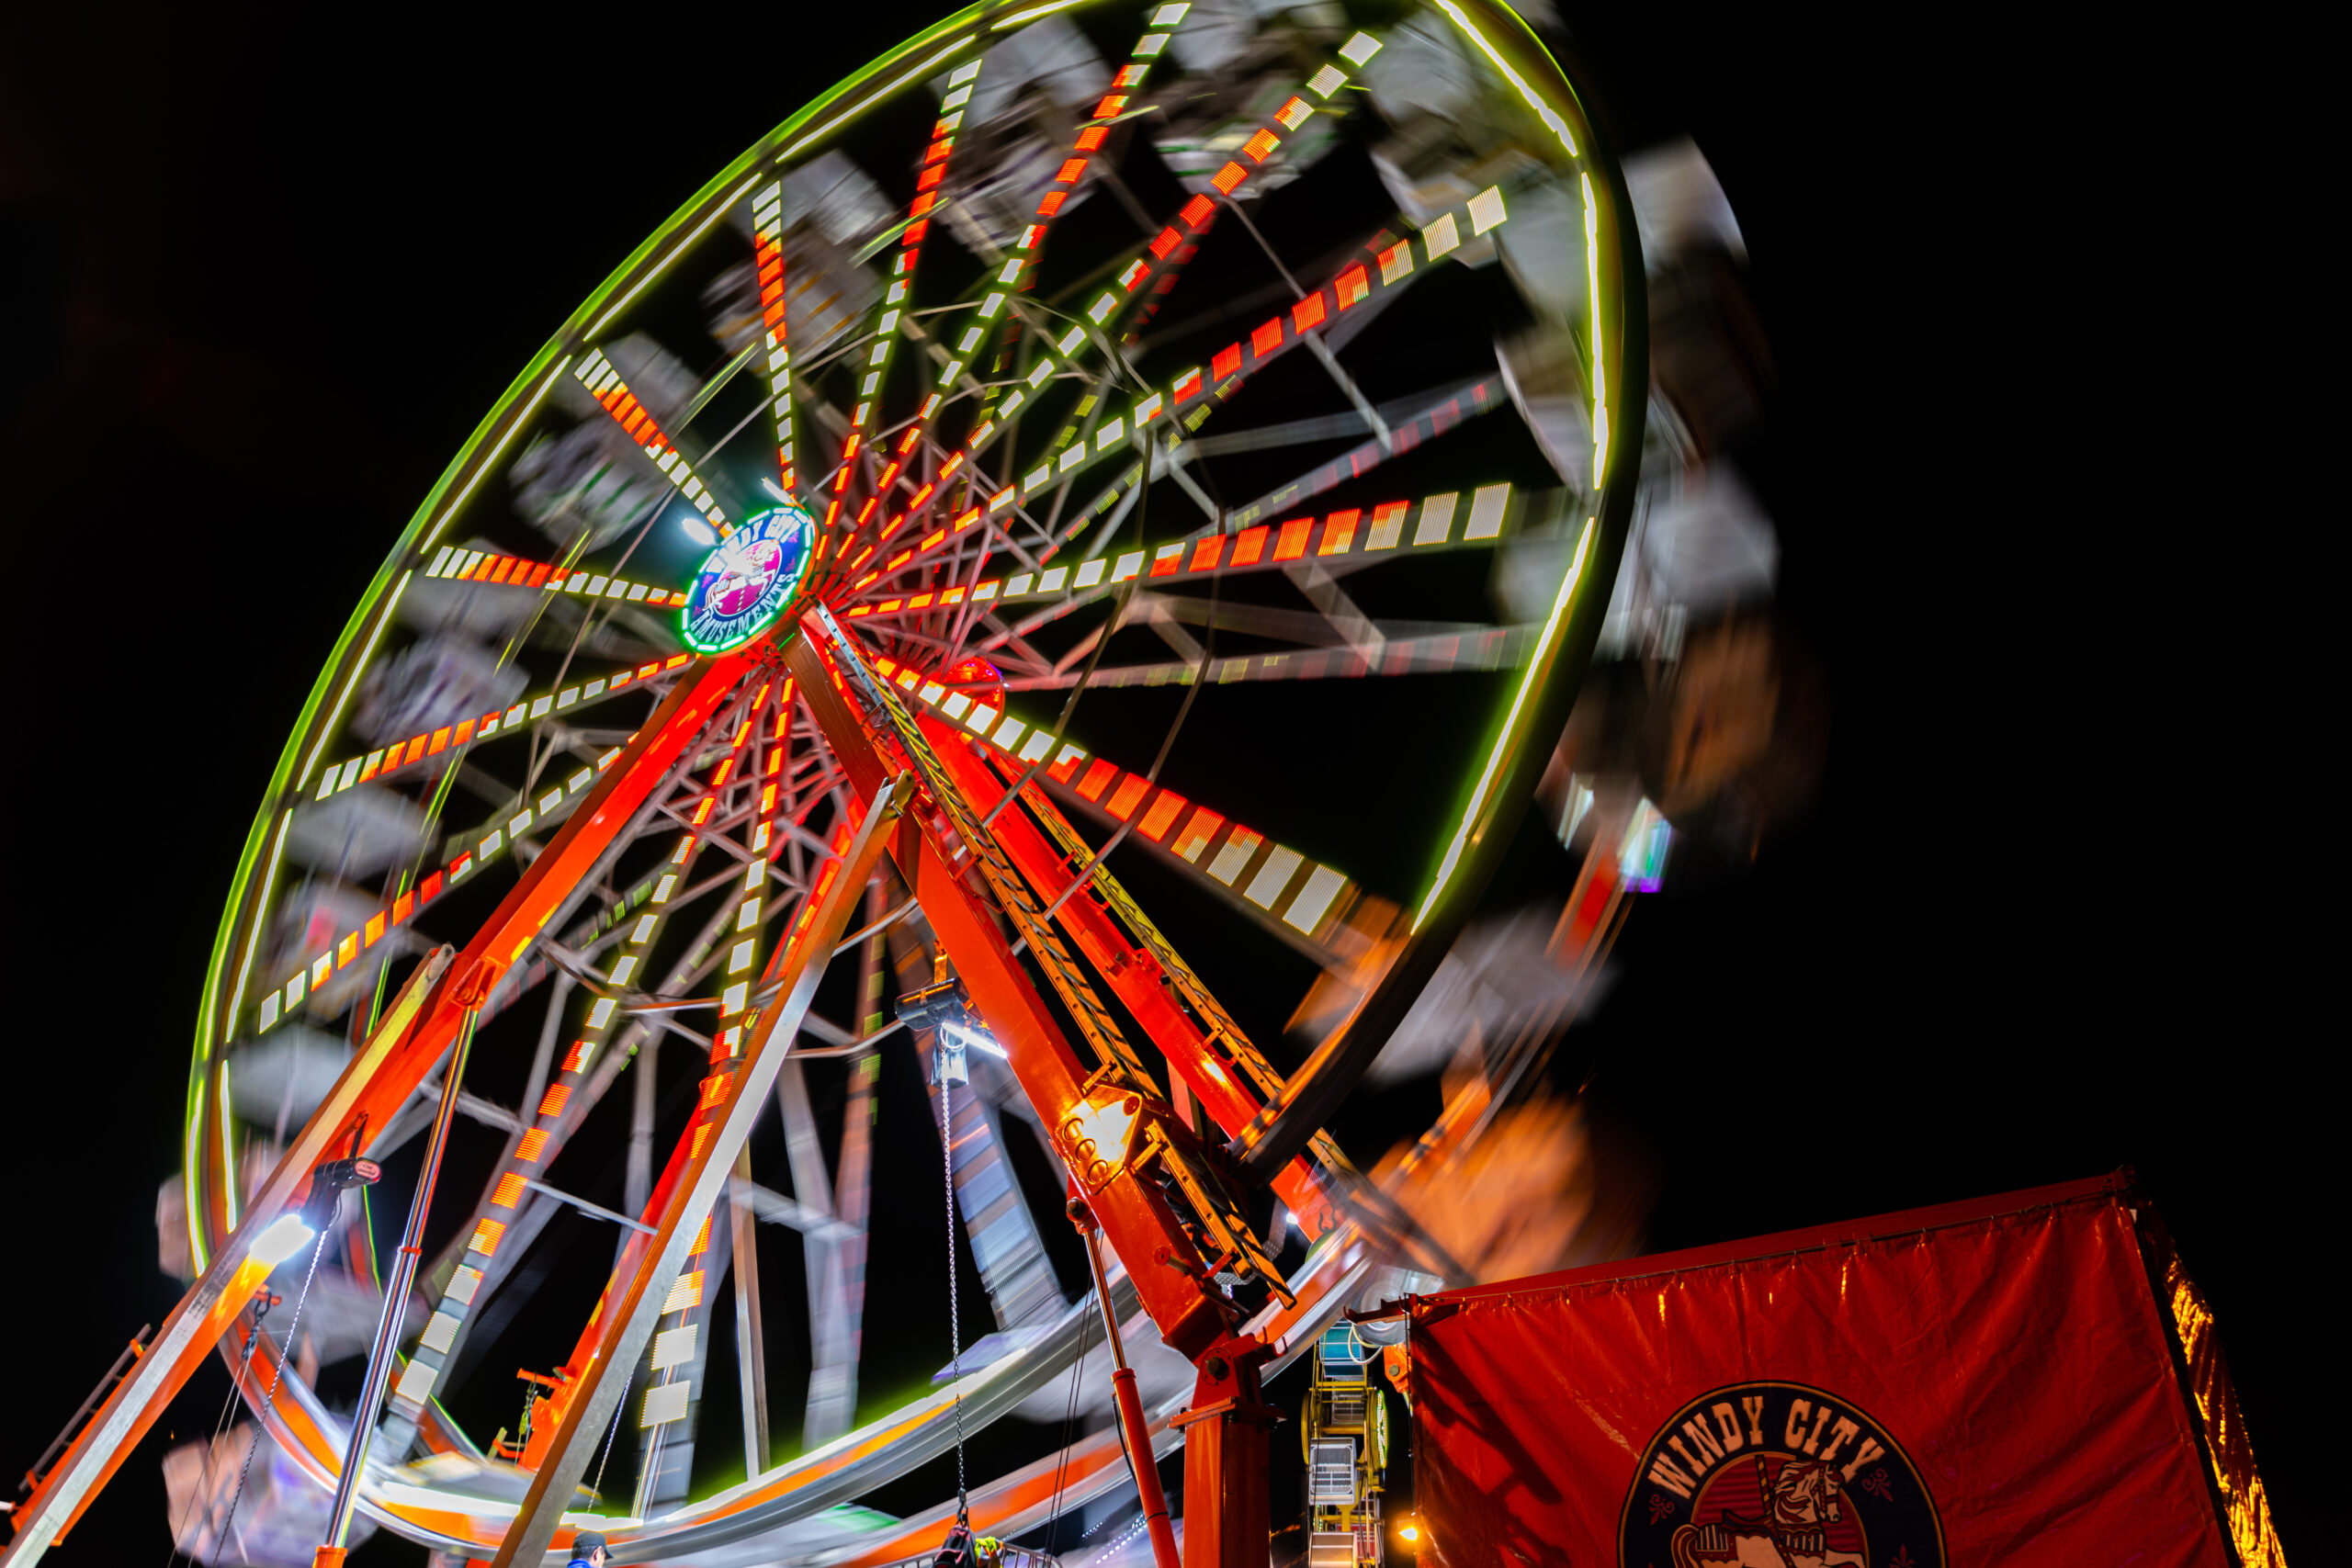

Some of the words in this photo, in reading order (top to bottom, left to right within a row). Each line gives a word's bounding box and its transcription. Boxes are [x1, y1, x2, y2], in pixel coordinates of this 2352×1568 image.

[764, 513, 801, 544] CITY
[690, 573, 796, 644] AMUSEMENTS
[1647, 1395, 1764, 1500] WINDY
[1784, 1398, 1885, 1483] CITY
